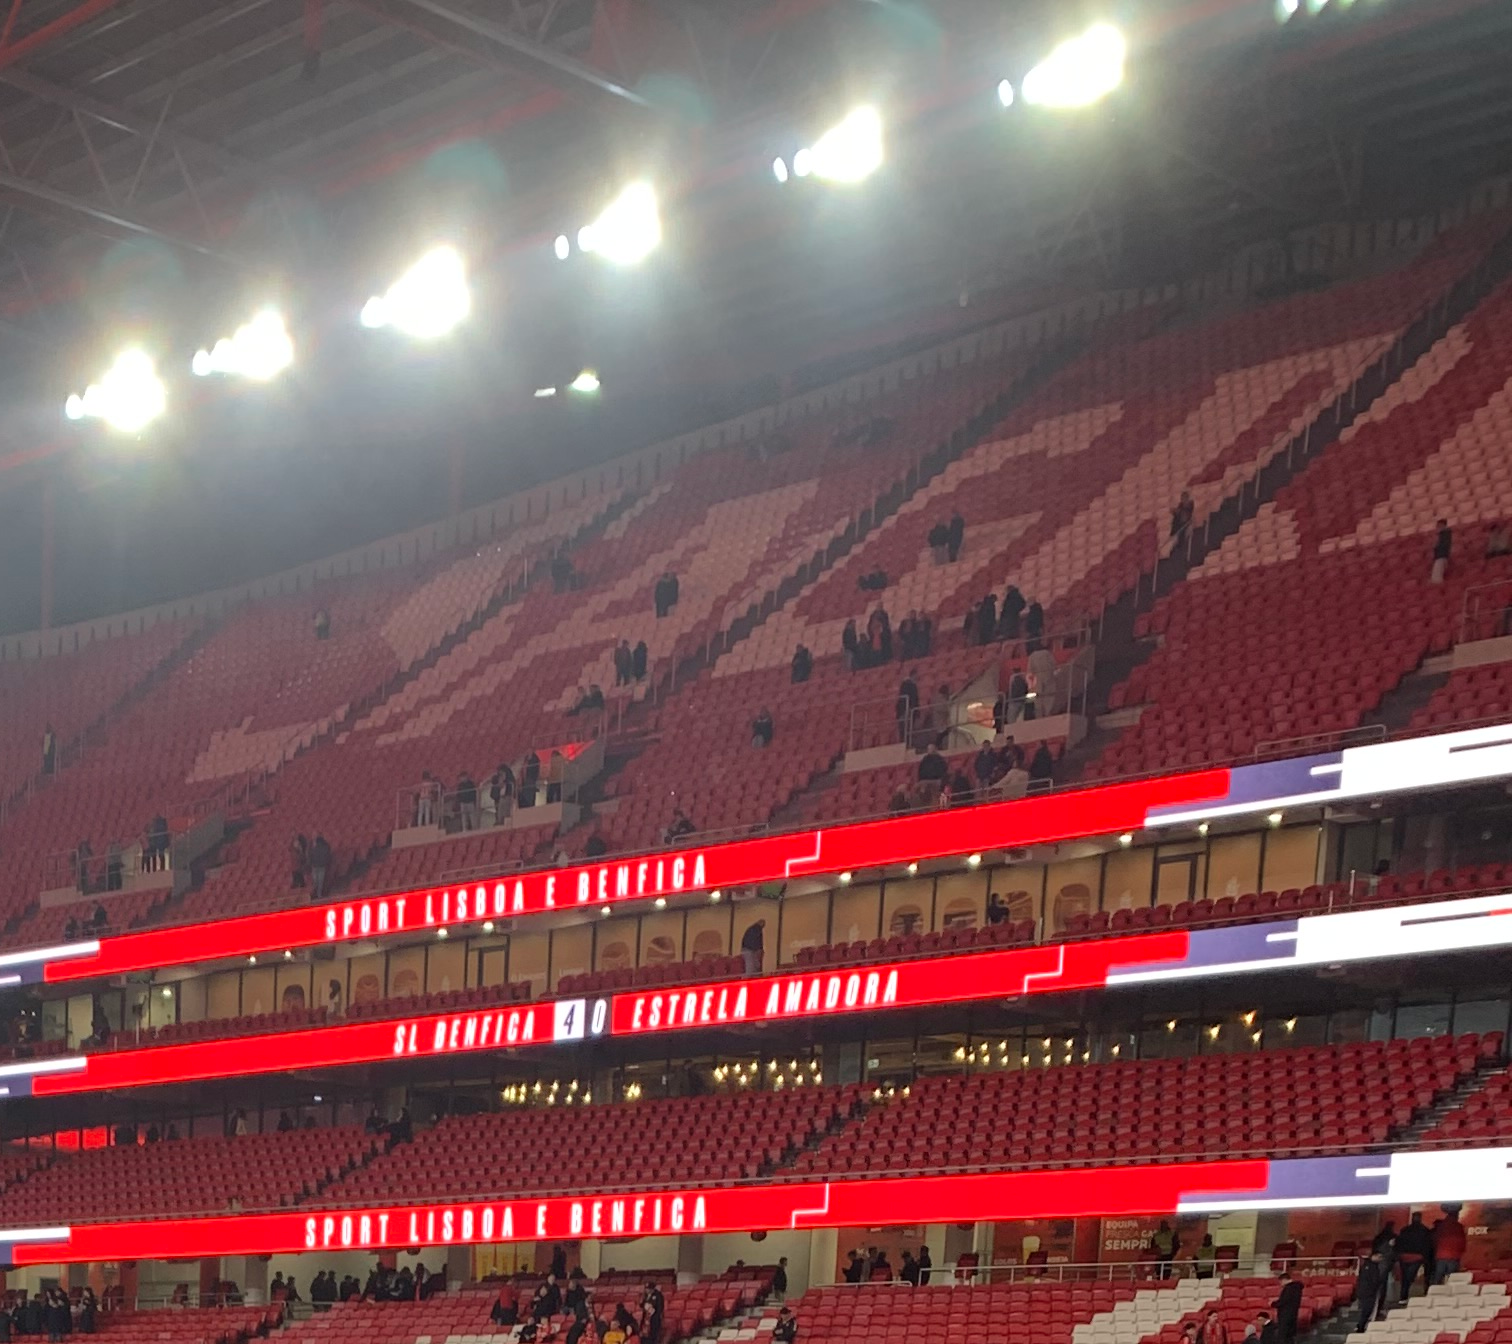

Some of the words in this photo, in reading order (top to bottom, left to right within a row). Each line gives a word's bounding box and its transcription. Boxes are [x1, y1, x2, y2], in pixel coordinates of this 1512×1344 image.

[326, 899, 406, 938] SPORT
[425, 880, 524, 923] LISBOA
[546, 876, 556, 906] E
[578, 855, 705, 902] BENFICA
[394, 1024, 418, 1055] SL
[434, 1011, 535, 1049] BENFICA
[563, 1004, 576, 1035] 4
[632, 986, 748, 1028] ESTRELA
[766, 970, 899, 1014] AMADORA
[305, 1214, 389, 1247] SPORT
[409, 1206, 513, 1242] LISBOA
[537, 1205, 547, 1235] E
[571, 1196, 706, 1234] BENFICA
